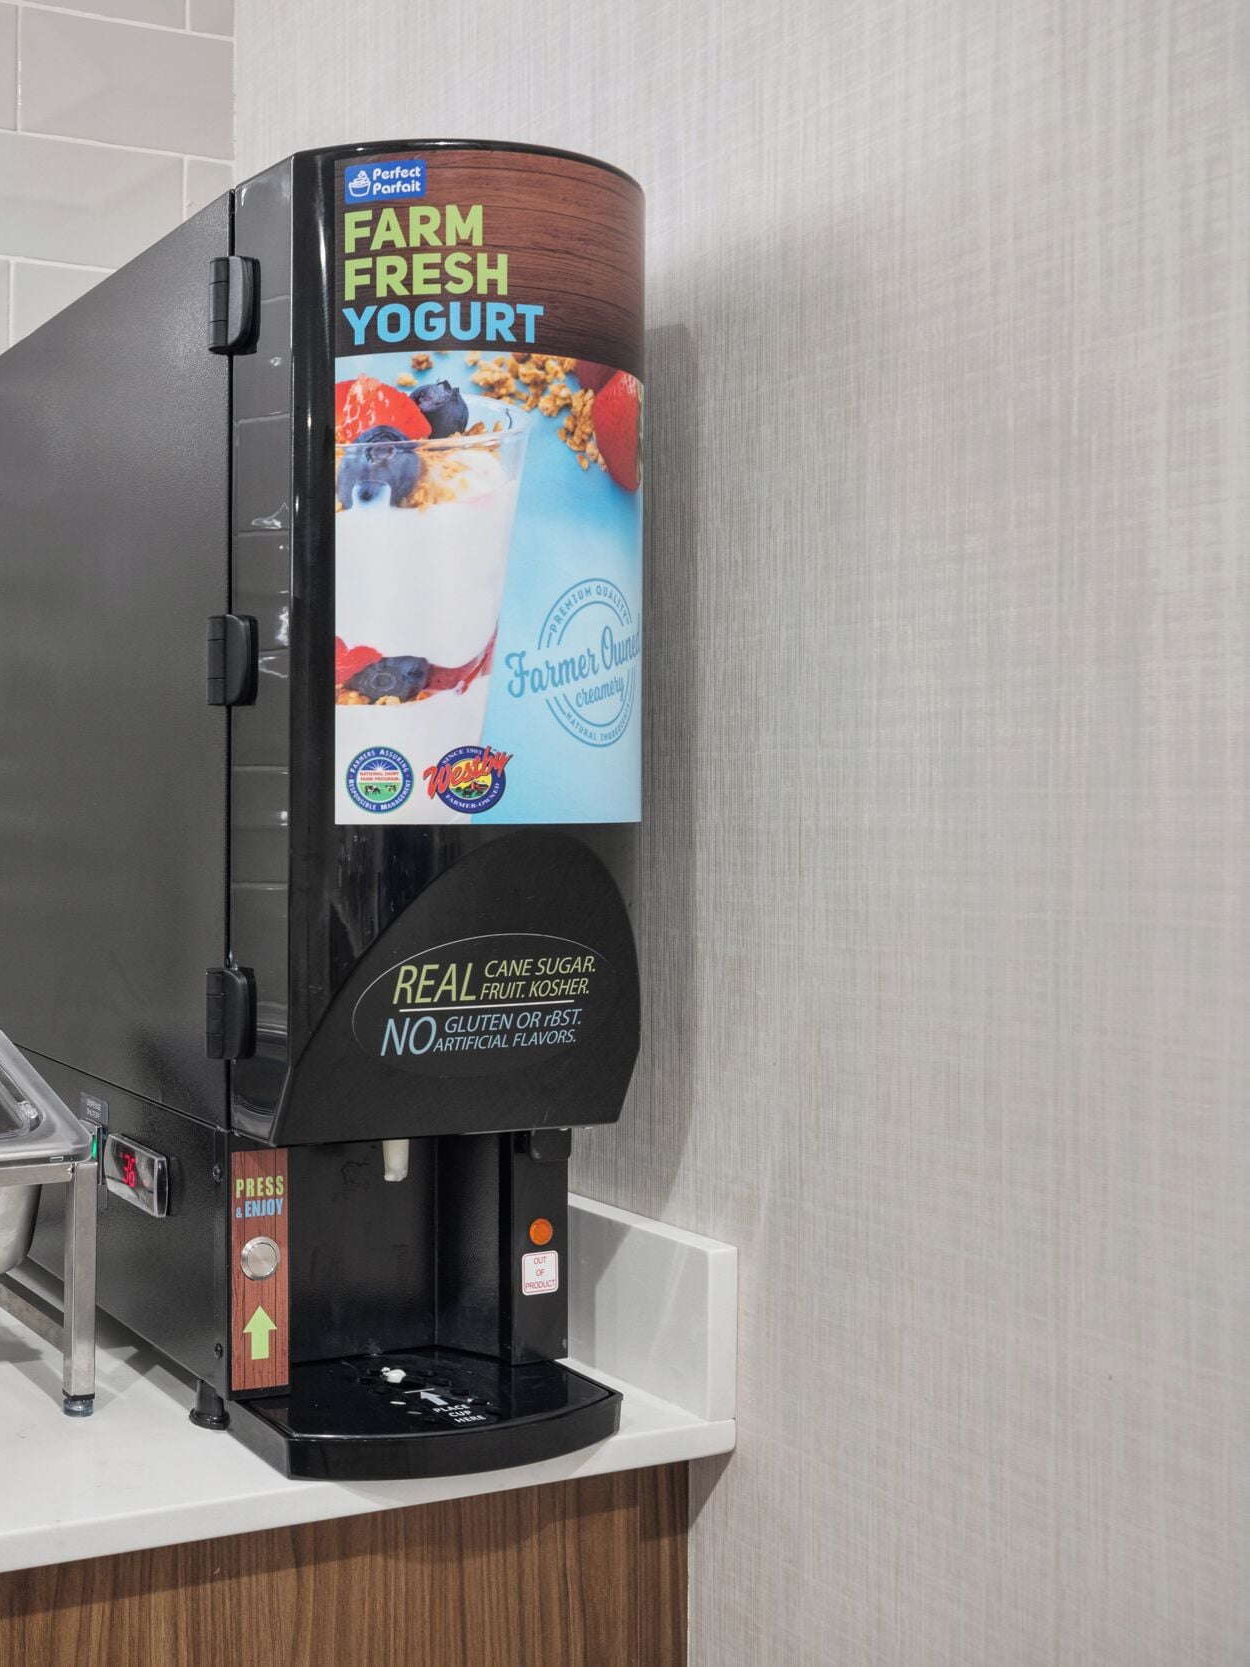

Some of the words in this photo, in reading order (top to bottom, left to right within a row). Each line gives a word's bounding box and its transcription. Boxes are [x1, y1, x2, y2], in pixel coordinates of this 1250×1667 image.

[372, 166, 421, 181] Perfect
[372, 181, 421, 195] Parfait
[344, 204, 483, 254] FARM
[344, 252, 508, 301] FRESH
[342, 301, 544, 346] YOGURT
[550, 586, 592, 633] PREMIUM
[596, 585, 627, 618] QUALITY
[504, 647, 599, 699] Farmer
[575, 675, 624, 708] creamery
[565, 711, 598, 741] NATURAL
[442, 748, 465, 765] SINCE
[422, 745, 513, 800] Westby
[445, 783, 500, 809] FARMER-OWNED
[484, 958, 533, 978] CANE
[536, 955, 596, 975] SUGAR.
[392, 963, 476, 1004] REAL
[480, 981, 525, 1000] FRUIT.
[529, 978, 589, 997] KOSHER.
[444, 1013, 512, 1033] GLUTEN
[516, 1011, 540, 1029] OR
[381, 1016, 437, 1056] NO
[434, 1034, 509, 1052] ARTIFICIAL
[512, 1029, 576, 1047] FLAVORS.
[236, 1175, 284, 1199] PRESS
[235, 1207, 243, 1218] &
[244, 1198, 284, 1218] ENJOY
[533, 1256, 547, 1265] OUT
[536, 1268, 545, 1277] OF
[525, 1280, 556, 1290] PRODUCT
[433, 1403, 471, 1414] PLACE
[449, 1410, 472, 1418] CUP
[454, 1414, 487, 1424] HERE
